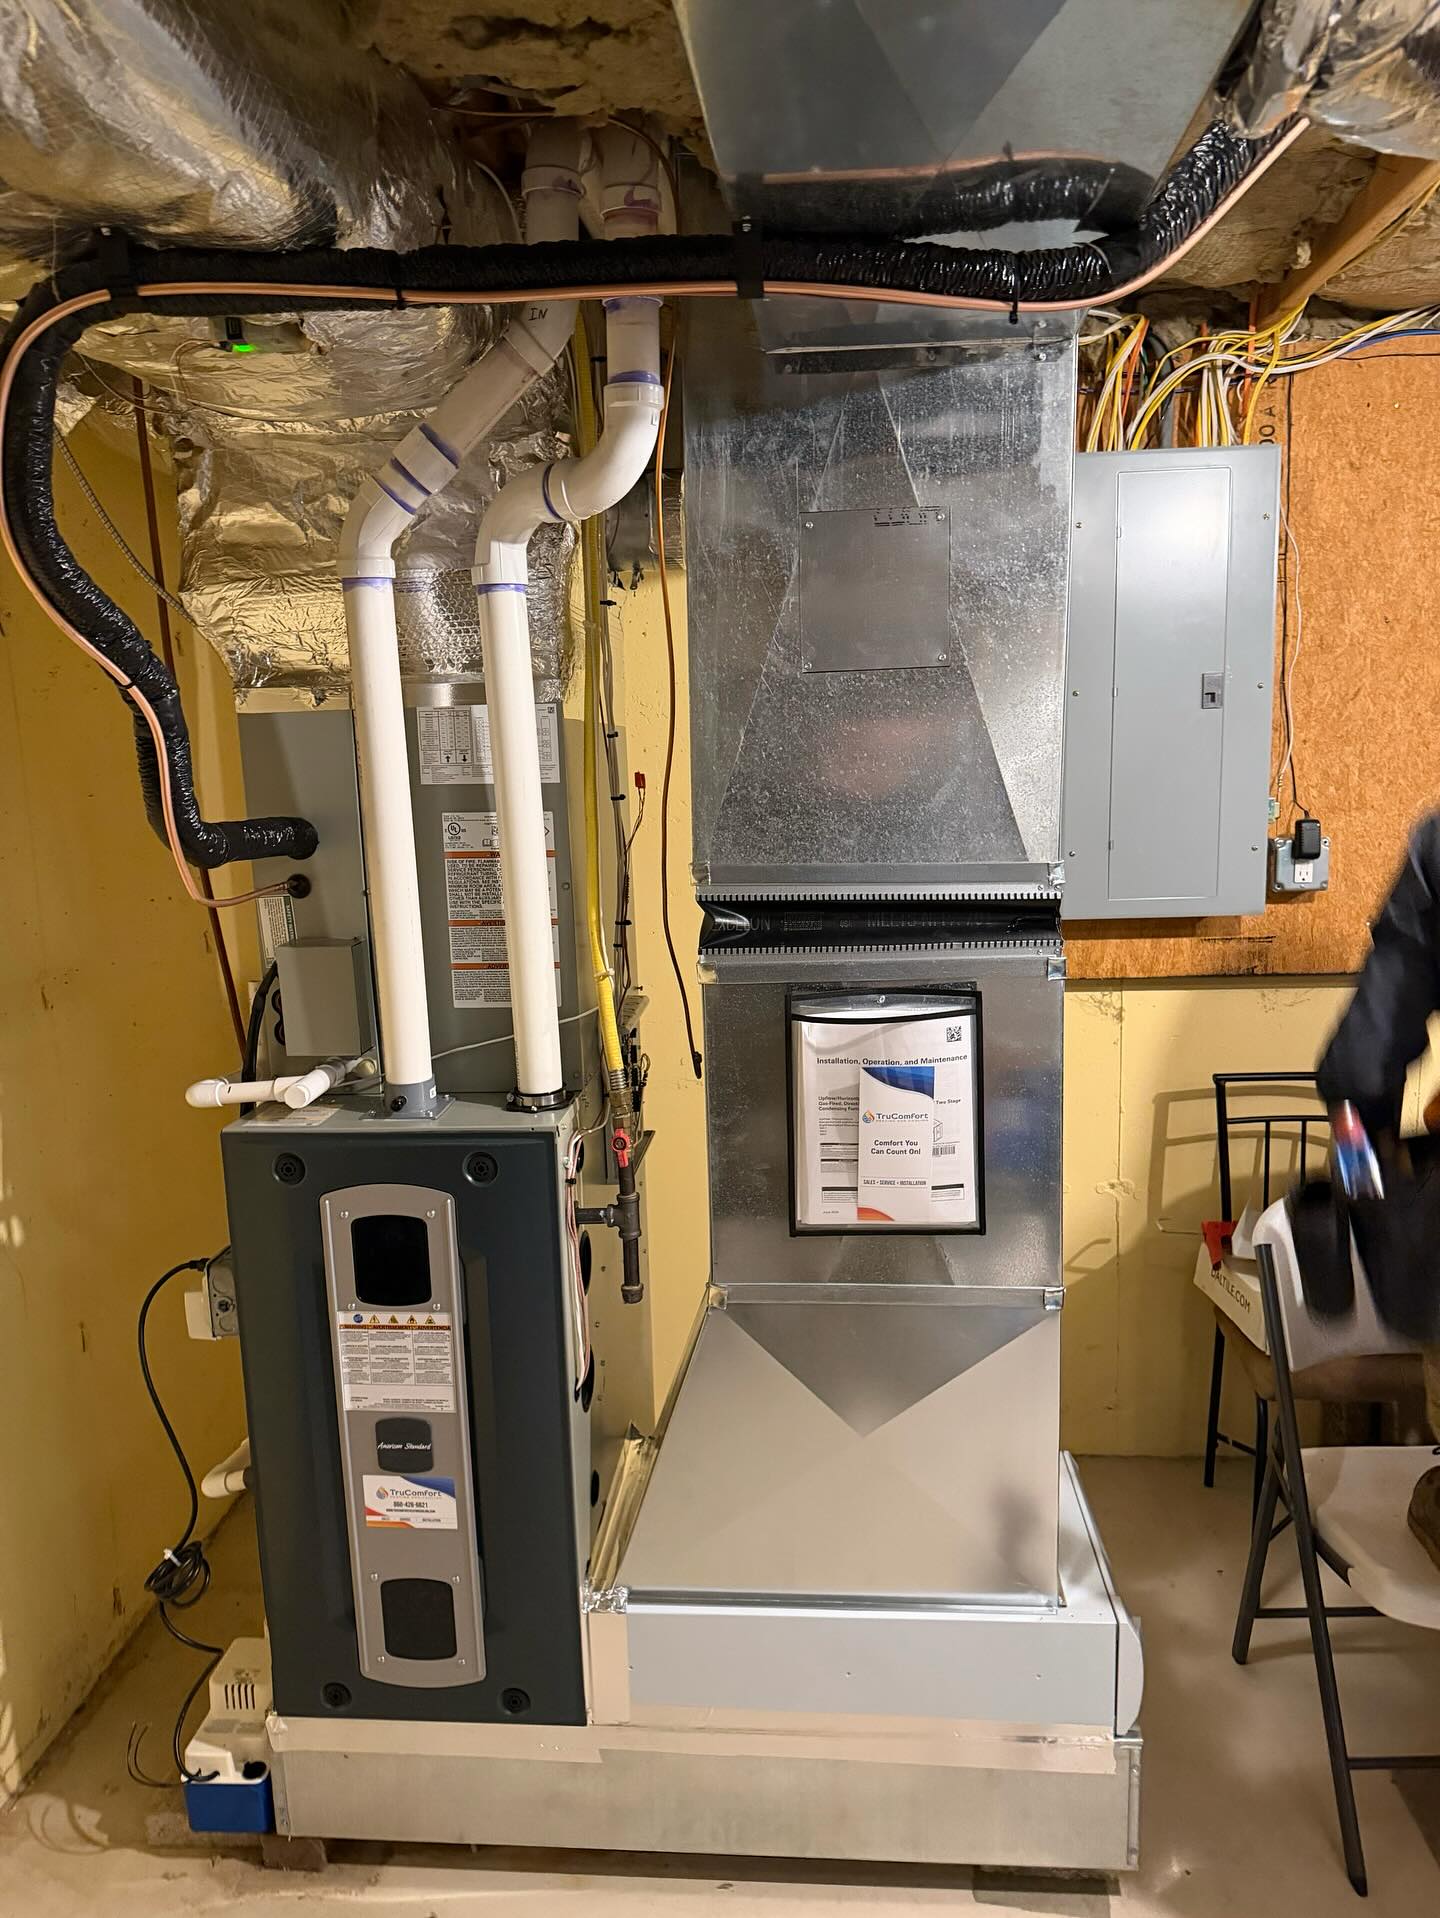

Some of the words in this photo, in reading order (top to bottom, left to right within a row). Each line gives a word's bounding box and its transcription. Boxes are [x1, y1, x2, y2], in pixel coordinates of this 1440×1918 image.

[528, 308, 548, 320] IN
[920, 1054, 968, 1064] Maintenance
[1210, 1269, 1250, 1314] DALTILE.COM
[377, 1442, 403, 1450] American
